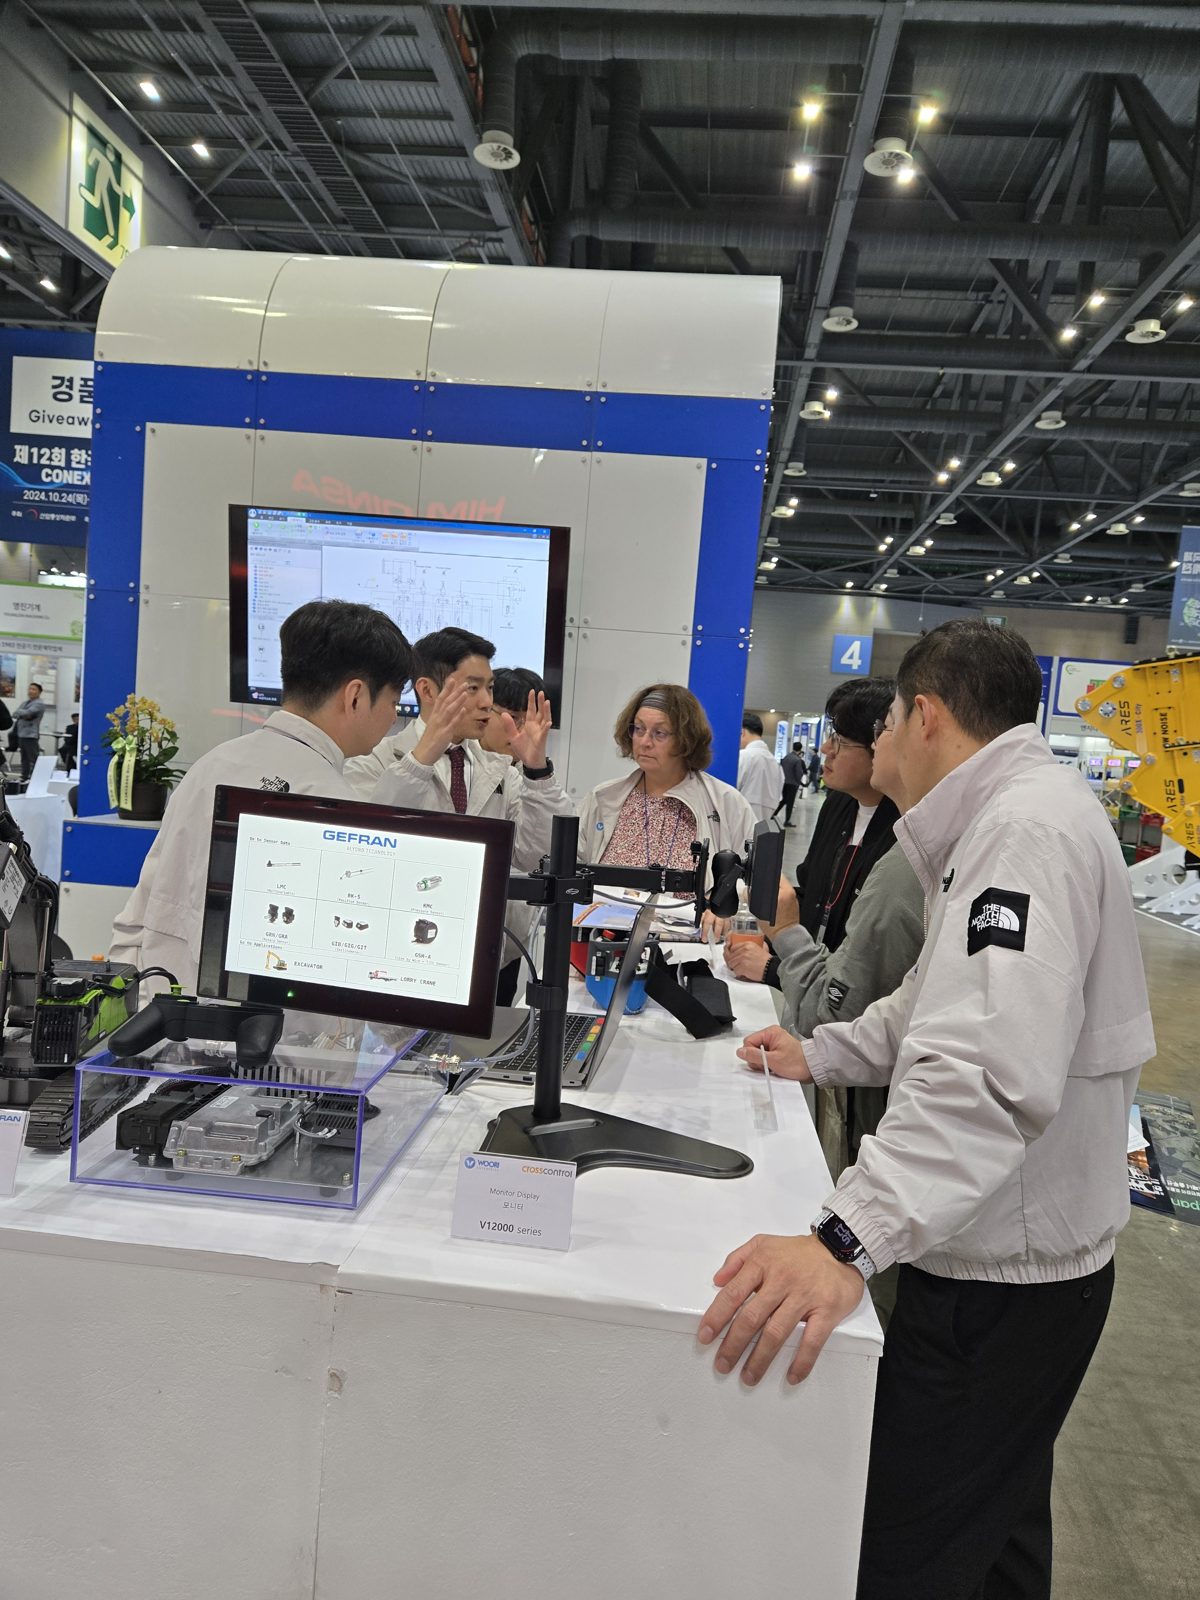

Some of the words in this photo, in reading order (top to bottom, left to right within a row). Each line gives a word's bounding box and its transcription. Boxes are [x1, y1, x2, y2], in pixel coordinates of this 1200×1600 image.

[28, 409, 92, 426] Giveaw
[13, 444, 66, 468] 제12회
[70, 448, 92, 469] 한
[41, 468, 91, 486] CONEX
[840, 640, 862, 670] 4
[1118, 700, 1132, 736] ARES
[1159, 712, 1169, 735] NOISE
[1164, 779, 1178, 813] ARES
[323, 830, 397, 848] GEFRAN
[982, 903, 1001, 913] THE
[971, 910, 1000, 928] NORTH
[977, 918, 999, 932] FACE
[293, 961, 324, 970] EXCAVATOR
[420, 979, 436, 987] CRANE
[521, 1165, 573, 1178] crosscontrol
[489, 1187, 515, 1197] Monitor
[516, 1191, 540, 1201] Display
[502, 1201, 524, 1212] 모니터
[479, 1220, 514, 1233] V12000
[517, 1225, 542, 1237] series
